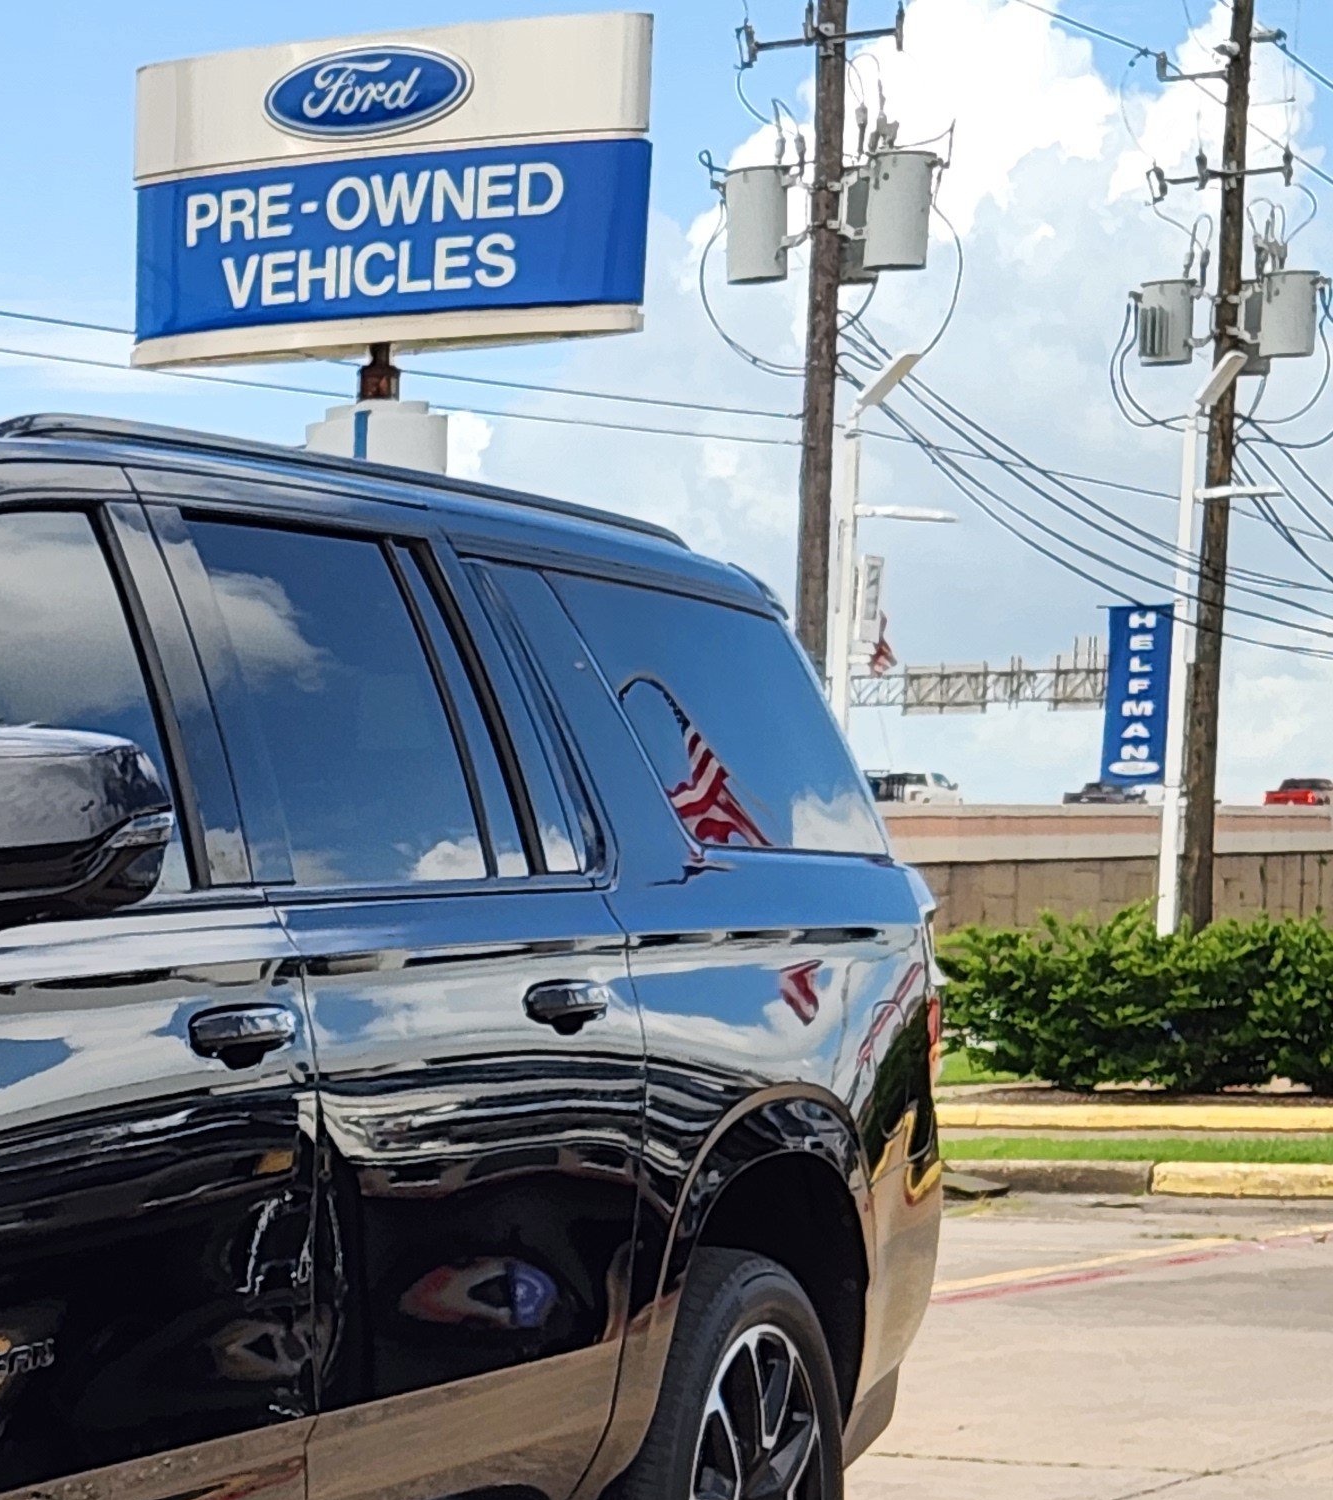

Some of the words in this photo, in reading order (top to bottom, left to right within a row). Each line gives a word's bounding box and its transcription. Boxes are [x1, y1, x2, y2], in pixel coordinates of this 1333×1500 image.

[302, 58, 422, 119] Ford
[185, 161, 565, 248] PRE-OWNED
[221, 233, 517, 309] VEHICLES
[1120, 611, 1157, 760] HELFMAN
